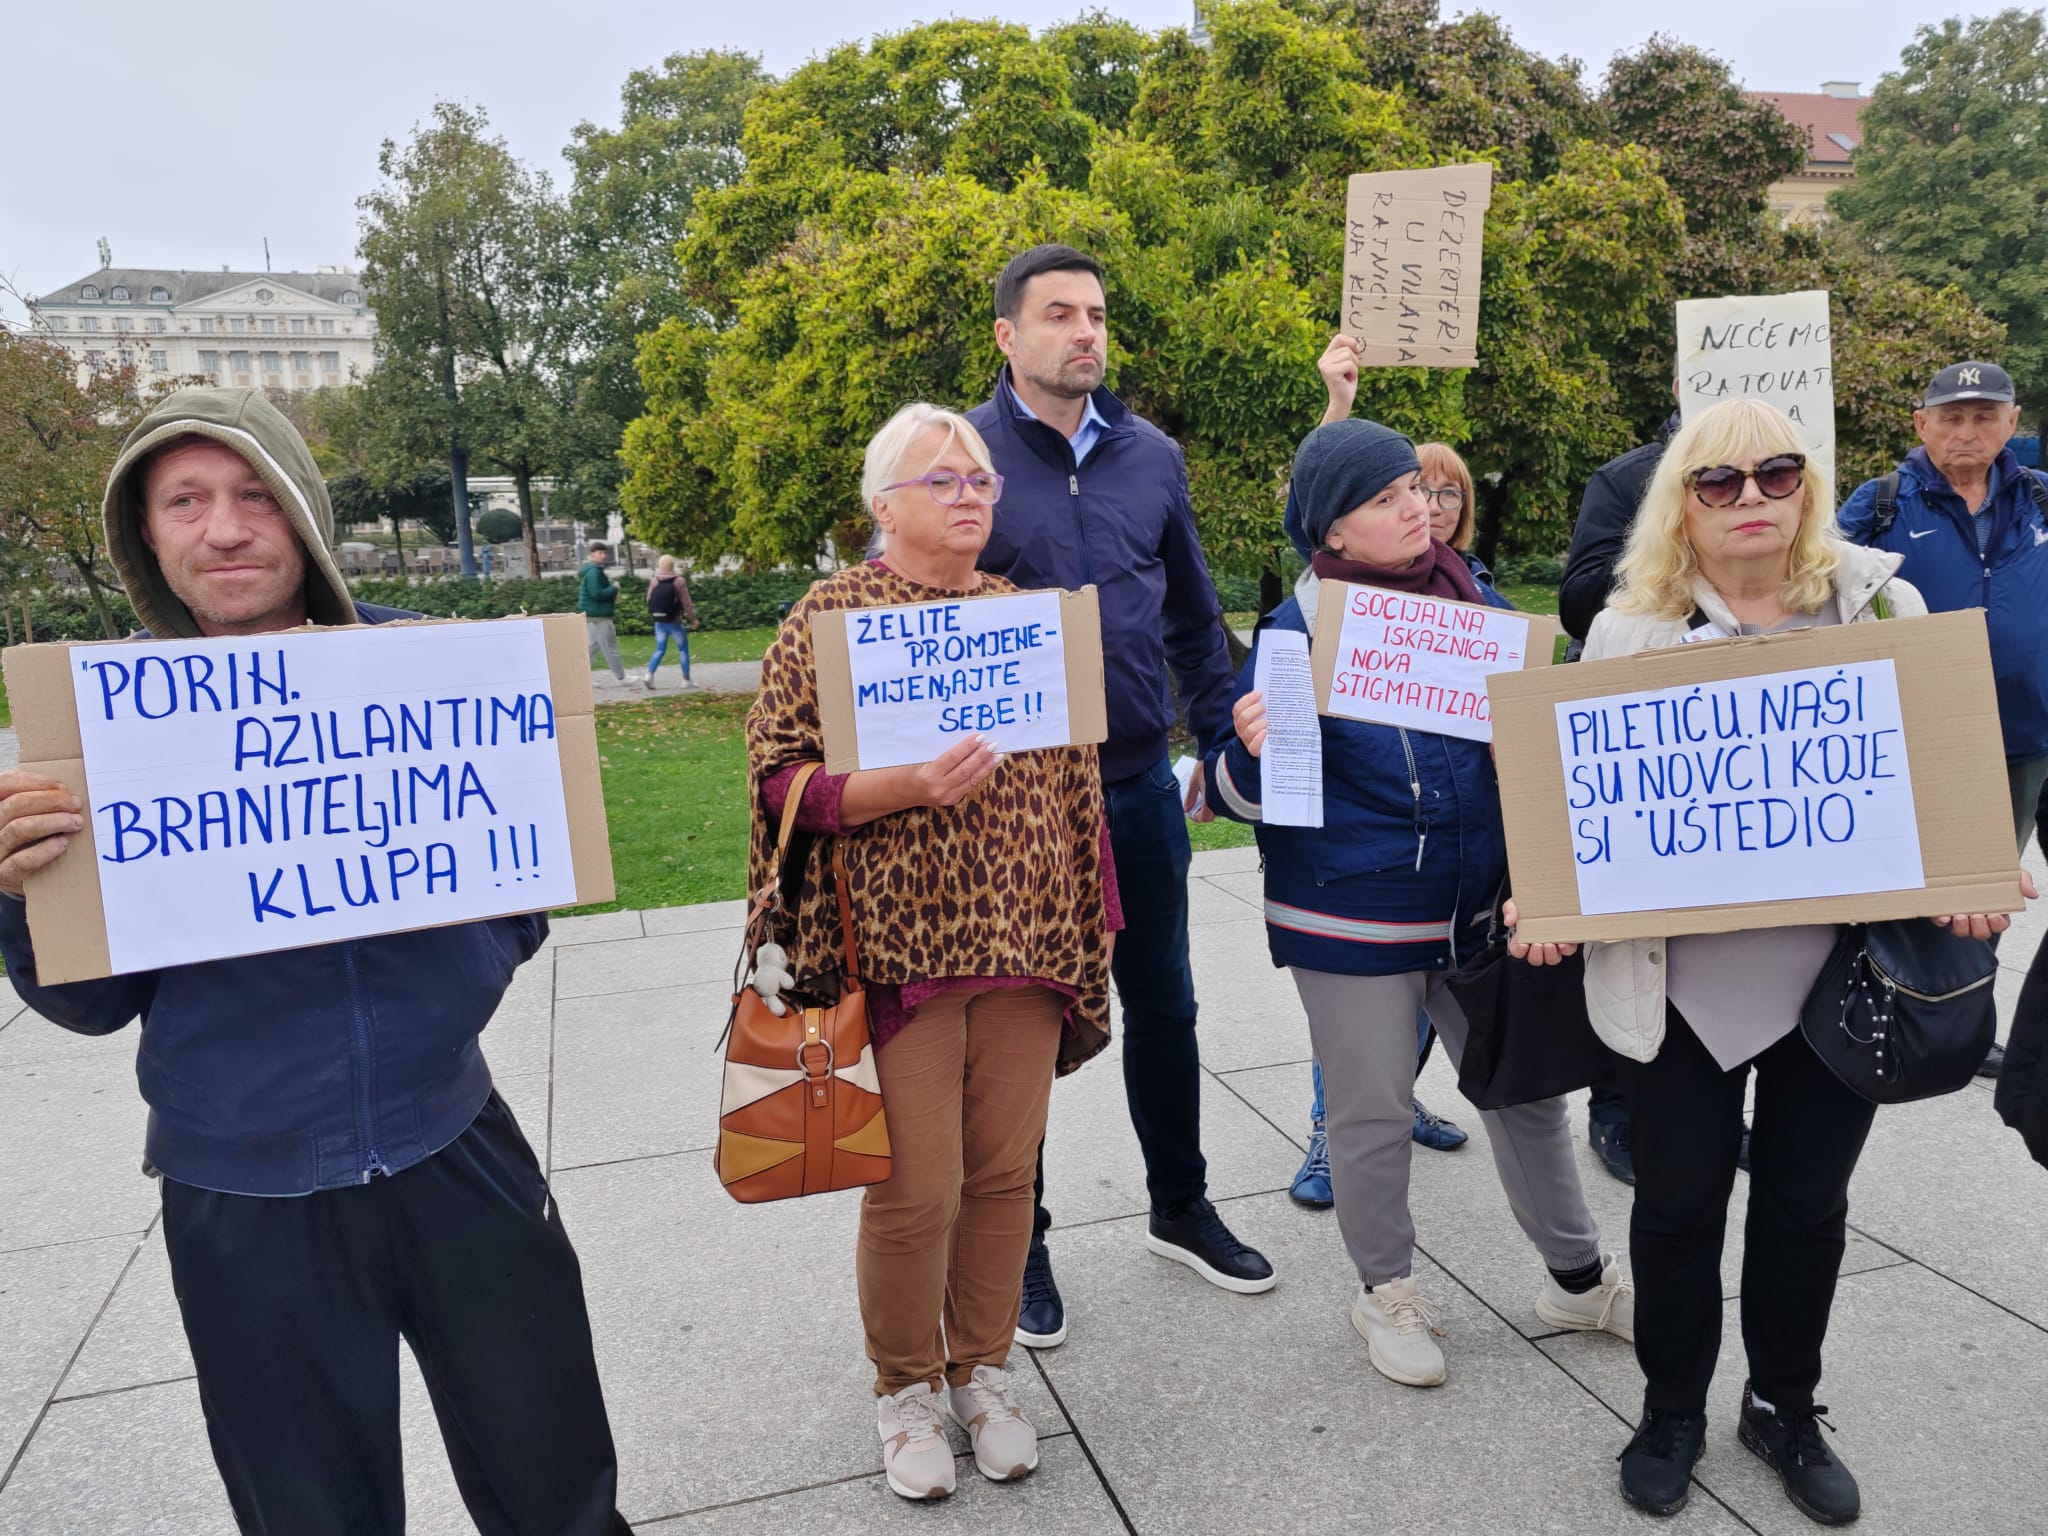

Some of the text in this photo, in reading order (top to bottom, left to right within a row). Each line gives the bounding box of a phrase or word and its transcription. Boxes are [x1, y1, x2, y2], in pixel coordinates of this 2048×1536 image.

[1348, 220, 1368, 360] NA KLUP
[1397, 221, 1425, 362] U VILAMA
[1437, 190, 1467, 353] DEZERTERI
[857, 605, 961, 645] ŽELITE
[1351, 591, 1486, 635] SOCIJALNA
[1382, 625, 1500, 662] ISKAZNICA
[1350, 647, 1412, 674] NOVA
[234, 693, 555, 772] AZILANTIMA
[1570, 729, 1898, 809] SU NOVCI KOJE
[1576, 815, 1611, 865] SI
[248, 842, 458, 923] KLUPA
